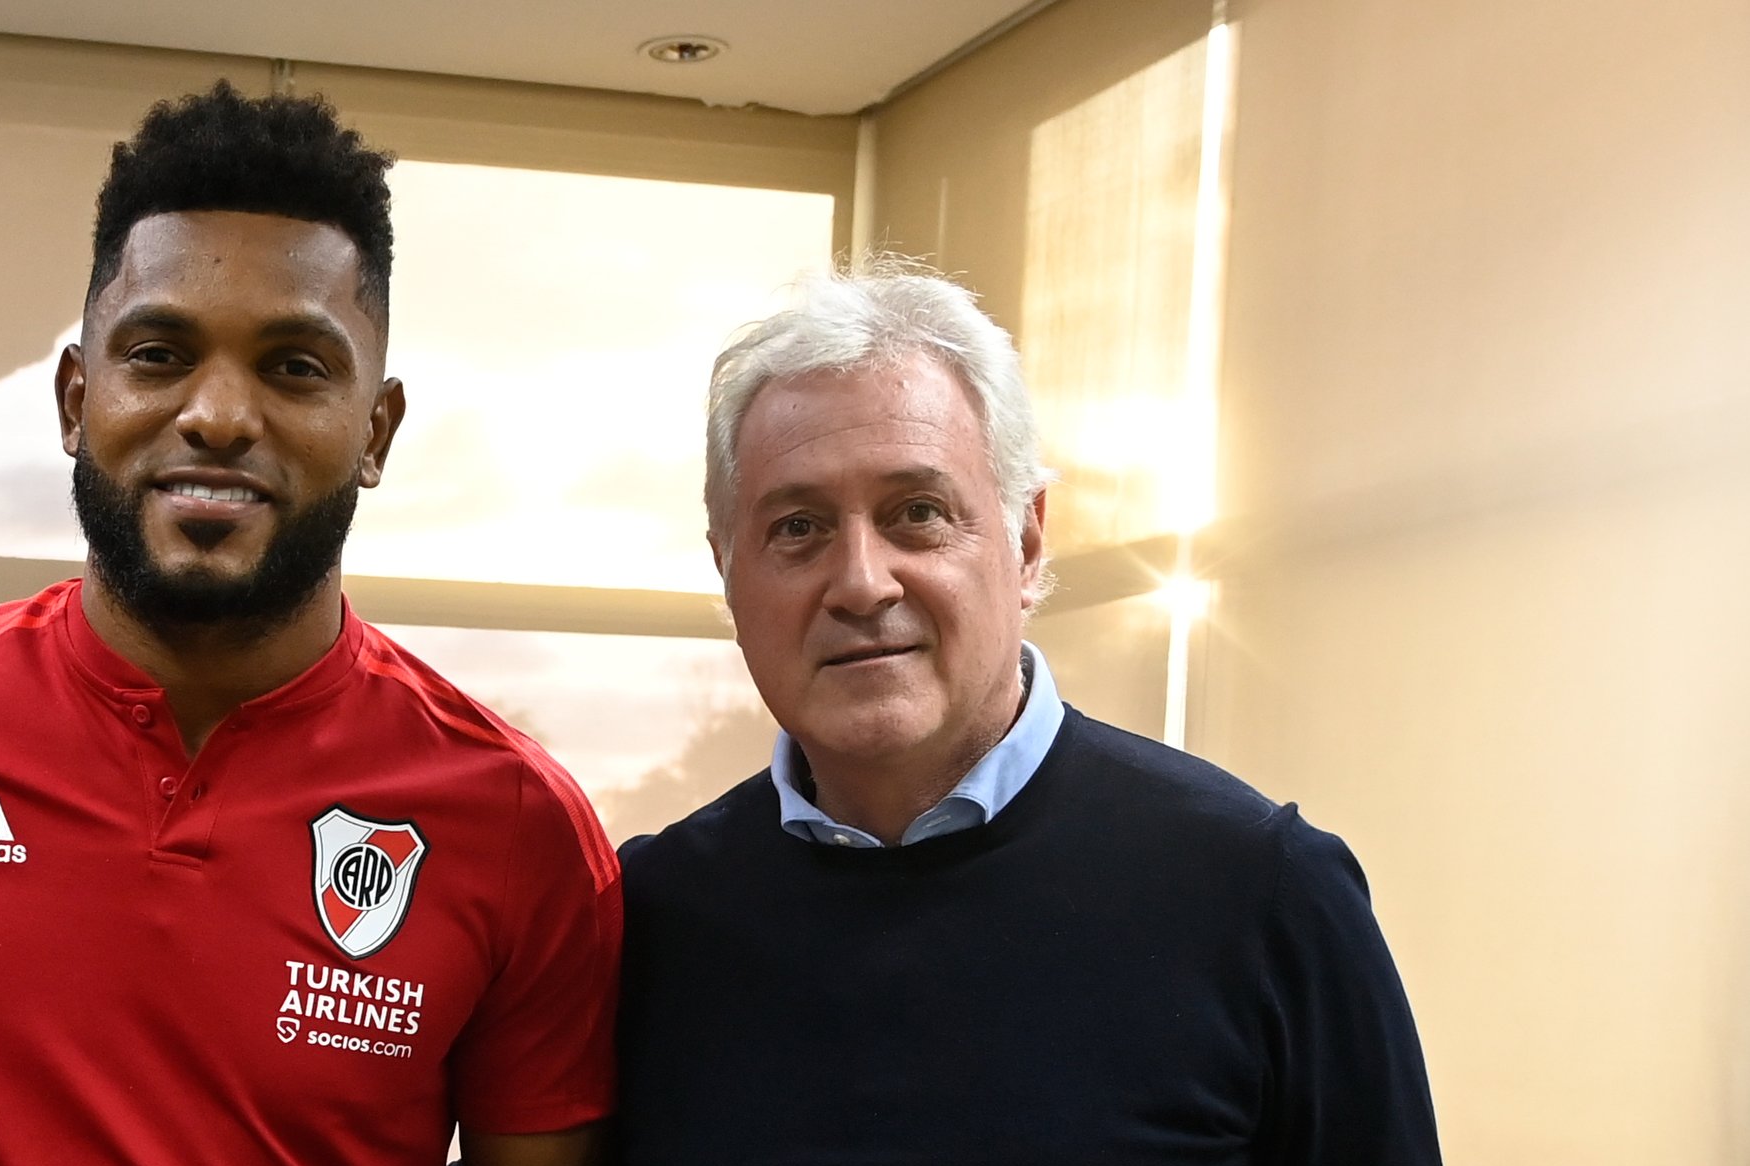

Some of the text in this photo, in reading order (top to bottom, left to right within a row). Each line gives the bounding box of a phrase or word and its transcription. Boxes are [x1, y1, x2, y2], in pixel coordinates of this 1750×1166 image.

[333, 846, 393, 908] CARP
[285, 960, 424, 1007] TURKISH
[279, 989, 421, 1035] AIRLINES
